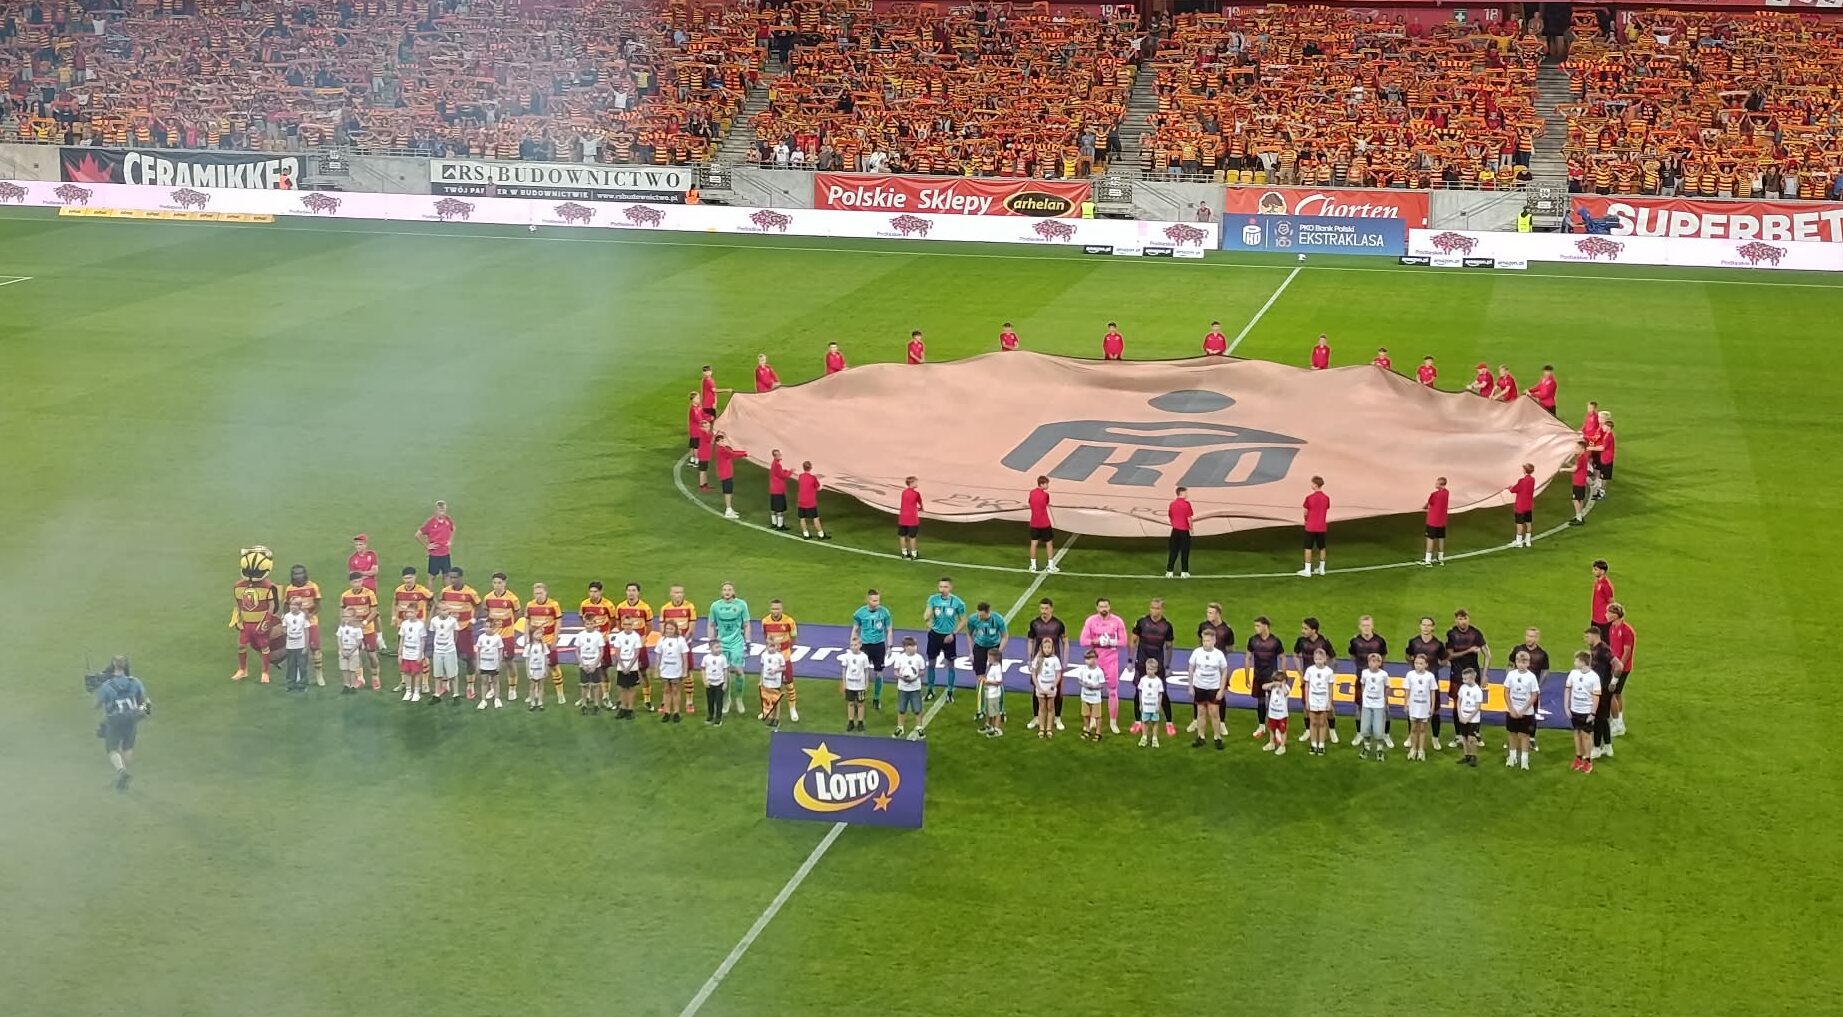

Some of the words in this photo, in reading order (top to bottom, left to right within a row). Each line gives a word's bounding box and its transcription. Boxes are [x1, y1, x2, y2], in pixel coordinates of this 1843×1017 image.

[1100, 4, 1114, 16] 19
[1483, 8, 1499, 21] 18
[123, 151, 299, 190] CERAMIKKER
[459, 165, 484, 181] RS
[497, 166, 680, 189] BUDOWNICTWO
[470, 187, 508, 196] PAER
[520, 189, 589, 199] BUDOWNICTWIE
[597, 192, 679, 202] www.rsbudownictwo.pl
[827, 185, 907, 208] Polskie
[917, 189, 993, 215] Sklepy
[1013, 195, 1065, 211] arhelan
[1294, 193, 1399, 219] Chorten
[1606, 202, 1843, 243] SUPERBET
[1299, 232, 1384, 247] EKSTRAKLASA
[815, 769, 880, 801] LOTTO
